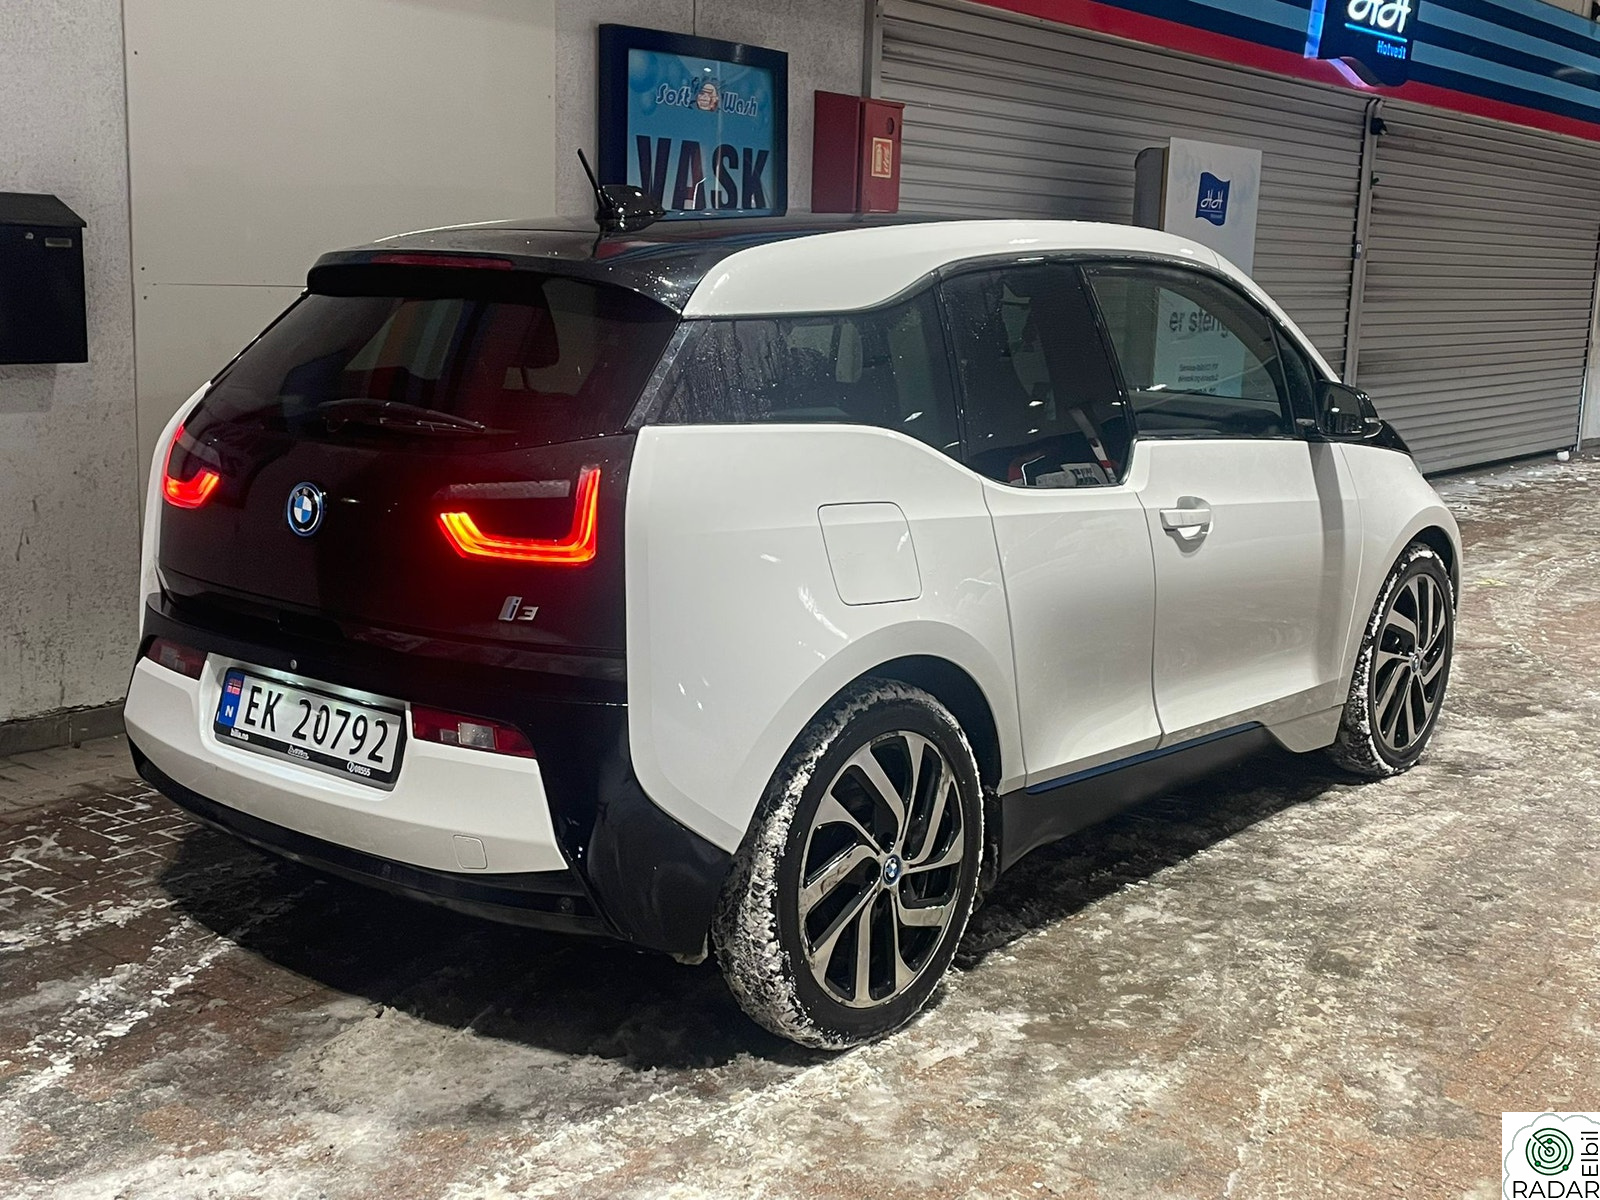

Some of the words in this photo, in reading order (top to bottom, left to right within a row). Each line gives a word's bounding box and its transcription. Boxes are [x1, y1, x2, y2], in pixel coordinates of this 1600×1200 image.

[656, 83, 692, 108] Soft
[723, 91, 758, 117] Wash
[636, 135, 770, 210] VASK
[1169, 311, 1186, 332] er
[225, 705, 234, 718] N
[244, 685, 284, 733] EK
[291, 698, 389, 764] 20792
